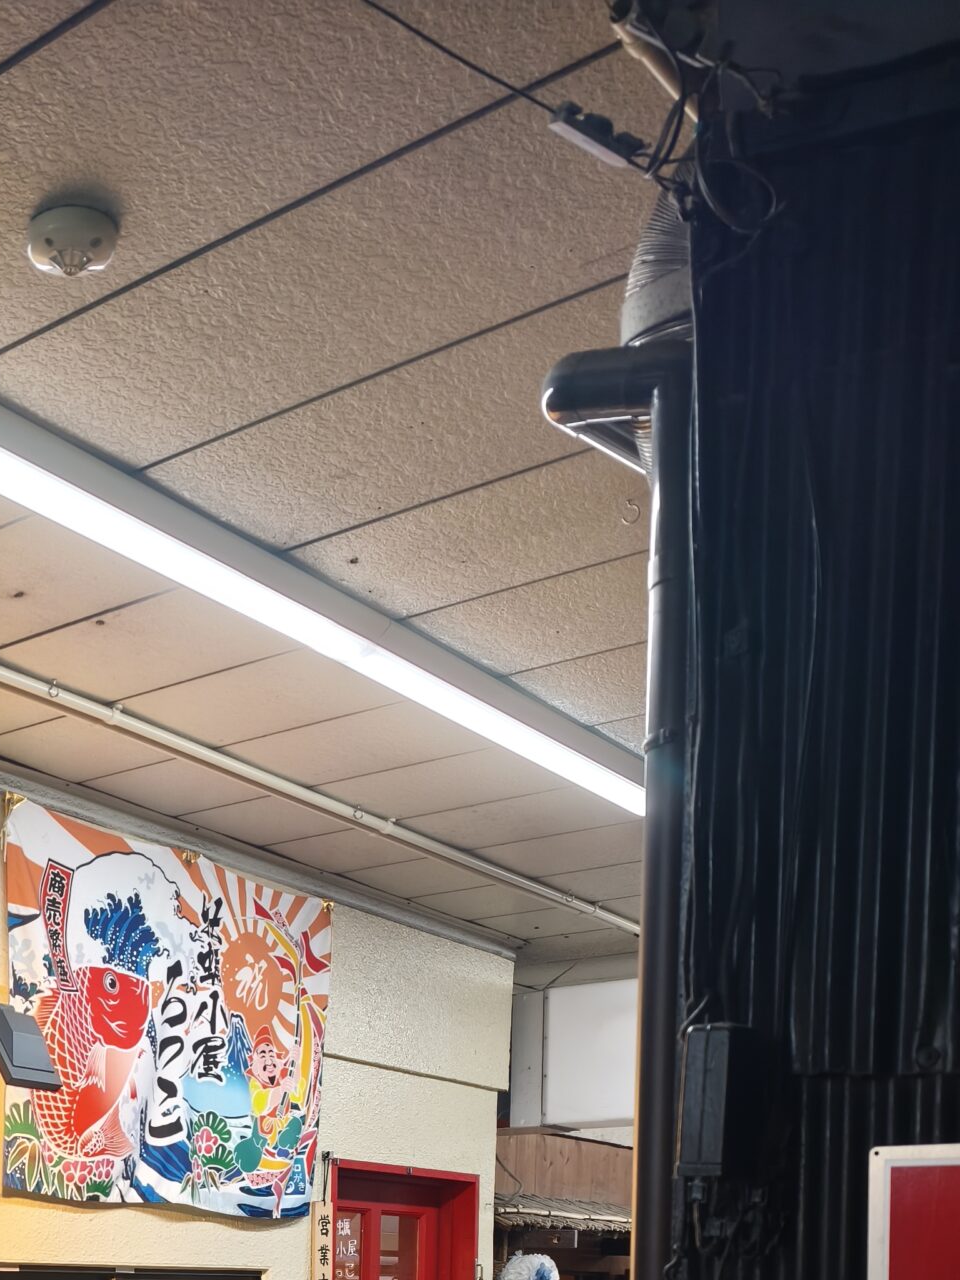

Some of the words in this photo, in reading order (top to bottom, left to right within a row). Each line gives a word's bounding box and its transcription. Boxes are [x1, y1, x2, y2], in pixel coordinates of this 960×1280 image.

[45, 870, 71, 985] 商売繁盛
[235, 952, 269, 1012] 祝
[191, 894, 229, 1083] 牡蠣小屋
[148, 959, 188, 1139] ろっこ
[336, 1239, 358, 1258] 小屋
